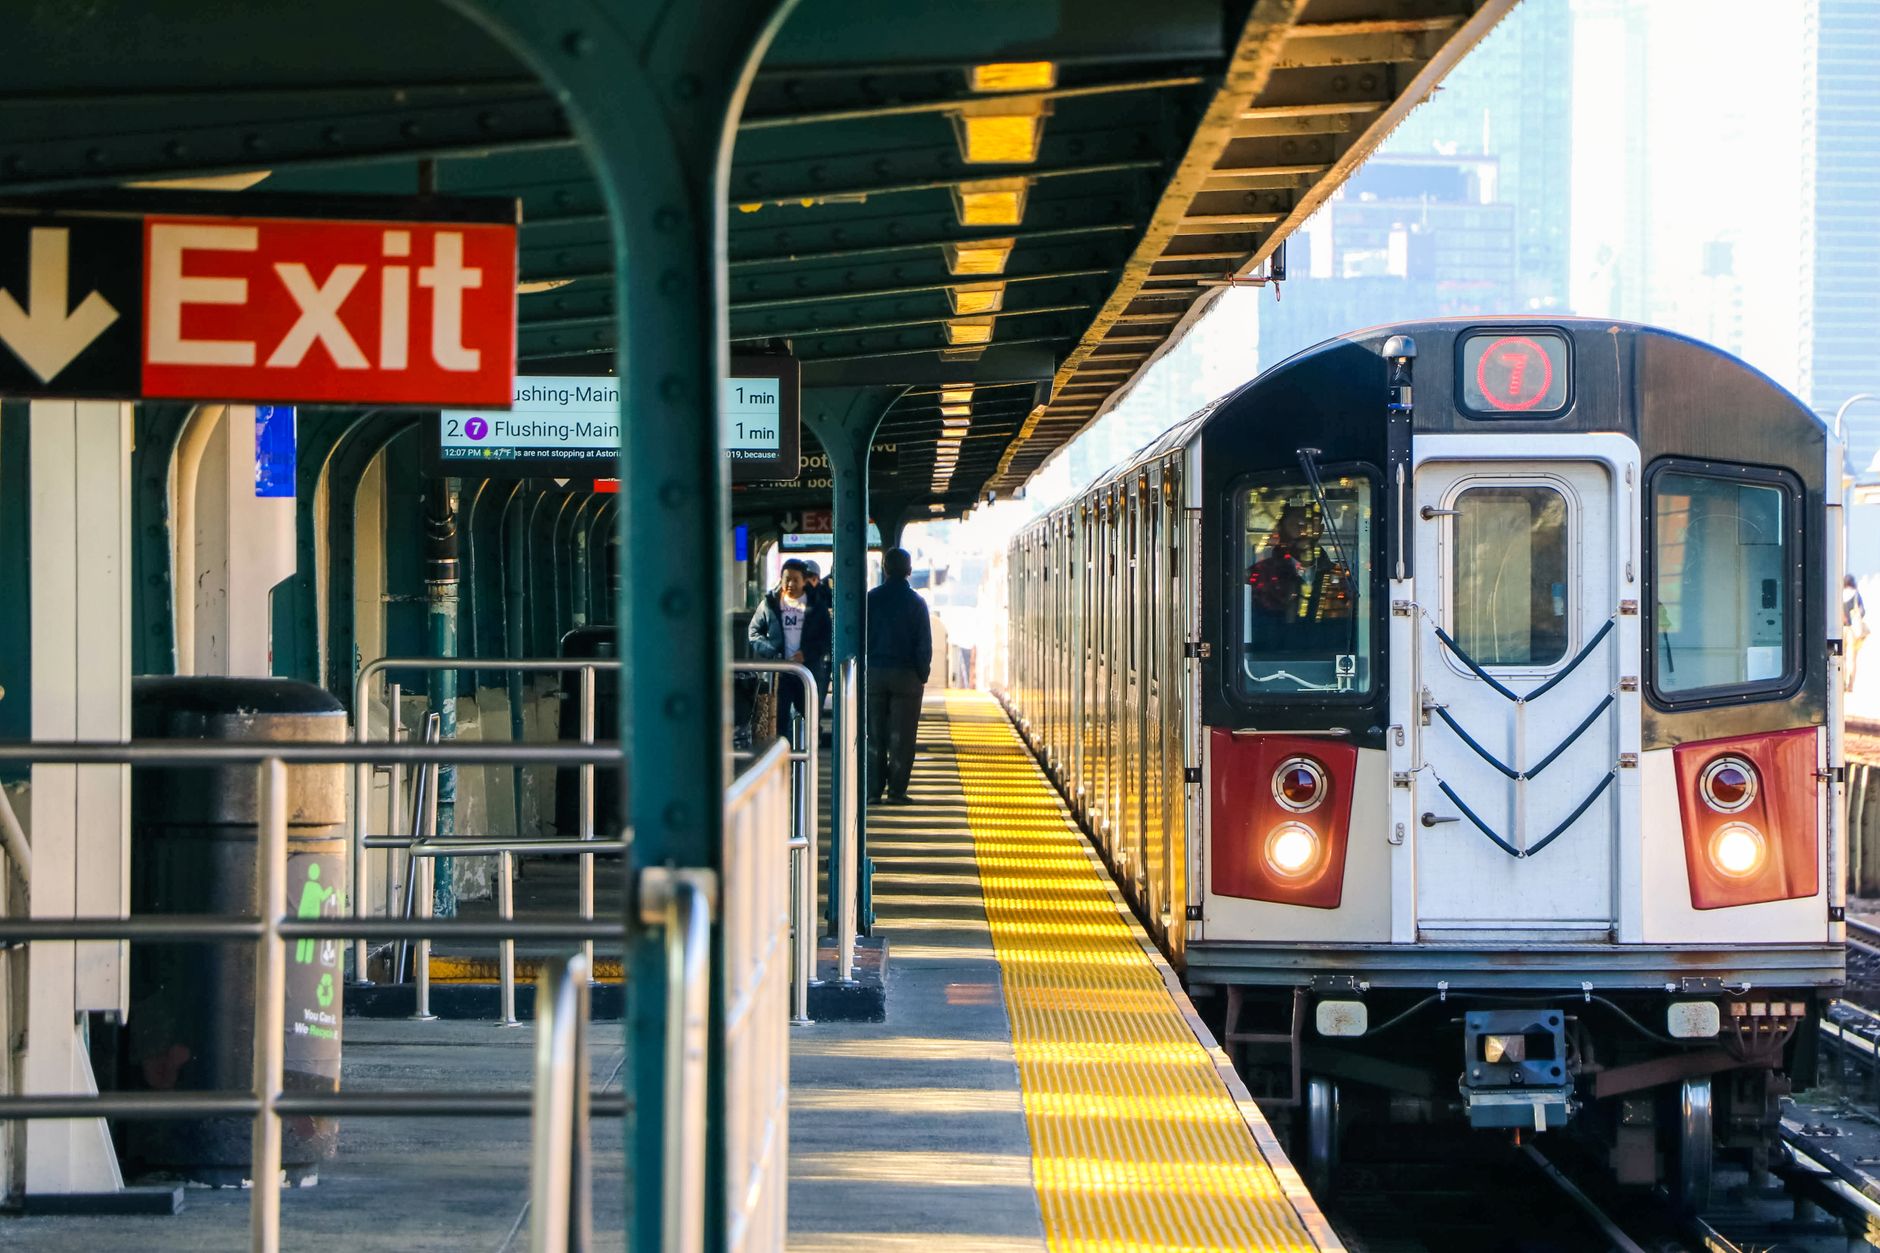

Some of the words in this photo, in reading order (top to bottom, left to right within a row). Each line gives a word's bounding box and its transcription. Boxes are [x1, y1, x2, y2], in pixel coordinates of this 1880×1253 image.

[147, 223, 482, 372] Exit
[1500, 353, 1527, 395] 7
[513, 386, 619, 406] ushing-Main
[735, 387, 744, 404] 1
[749, 392, 775, 404] min
[447, 419, 463, 437] 2.
[495, 421, 619, 441] Flushing-Main
[735, 422, 744, 439] 1
[749, 427, 775, 439] min
[445, 449, 466, 457] 12:07
[467, 449, 481, 457] PM
[551, 450, 585, 459] stopping
[595, 450, 621, 458] Astori
[724, 451, 743, 459] 019,
[744, 450, 776, 459] because
[303, 1008, 319, 1021] You
[294, 1021, 309, 1034] We
